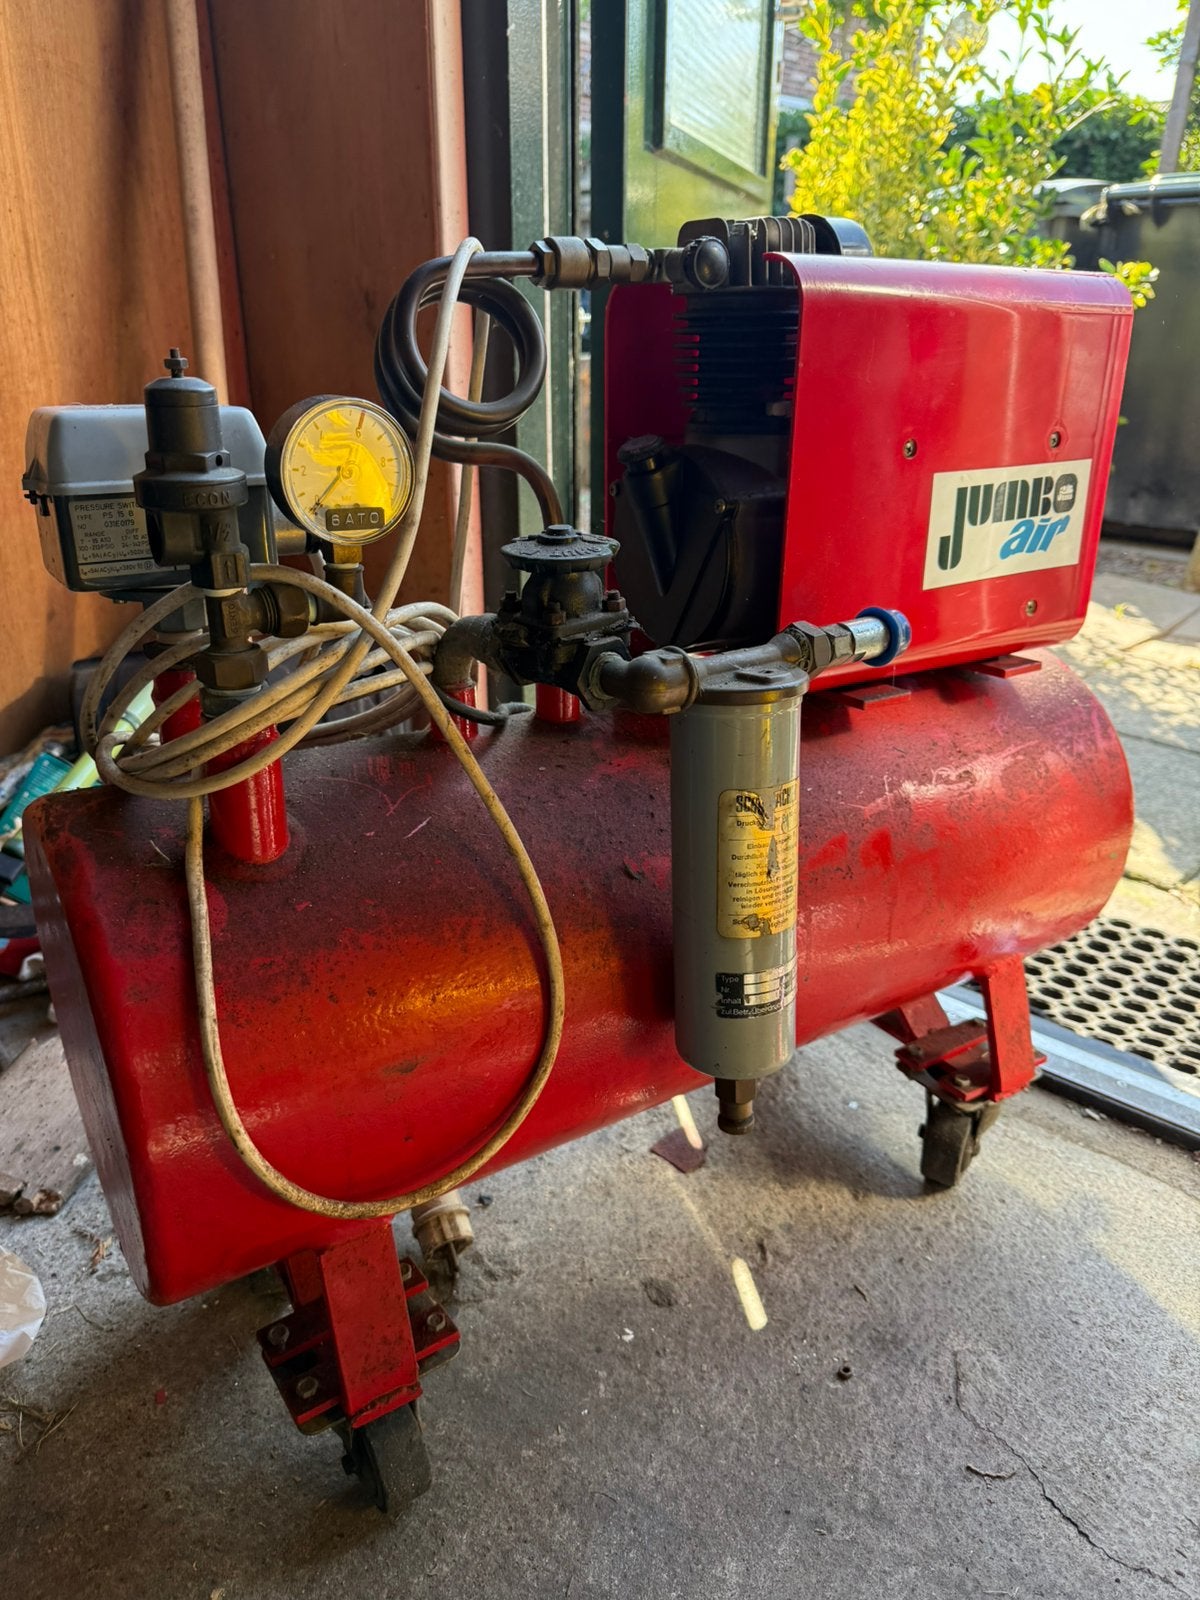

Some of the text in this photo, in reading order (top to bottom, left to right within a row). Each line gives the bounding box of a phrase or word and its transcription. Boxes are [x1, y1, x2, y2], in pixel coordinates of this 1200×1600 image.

[300, 465, 307, 477] 2
[74, 502, 115, 512] PRESSURE
[1000, 515, 1071, 560] air
[721, 975, 739, 983] Type
